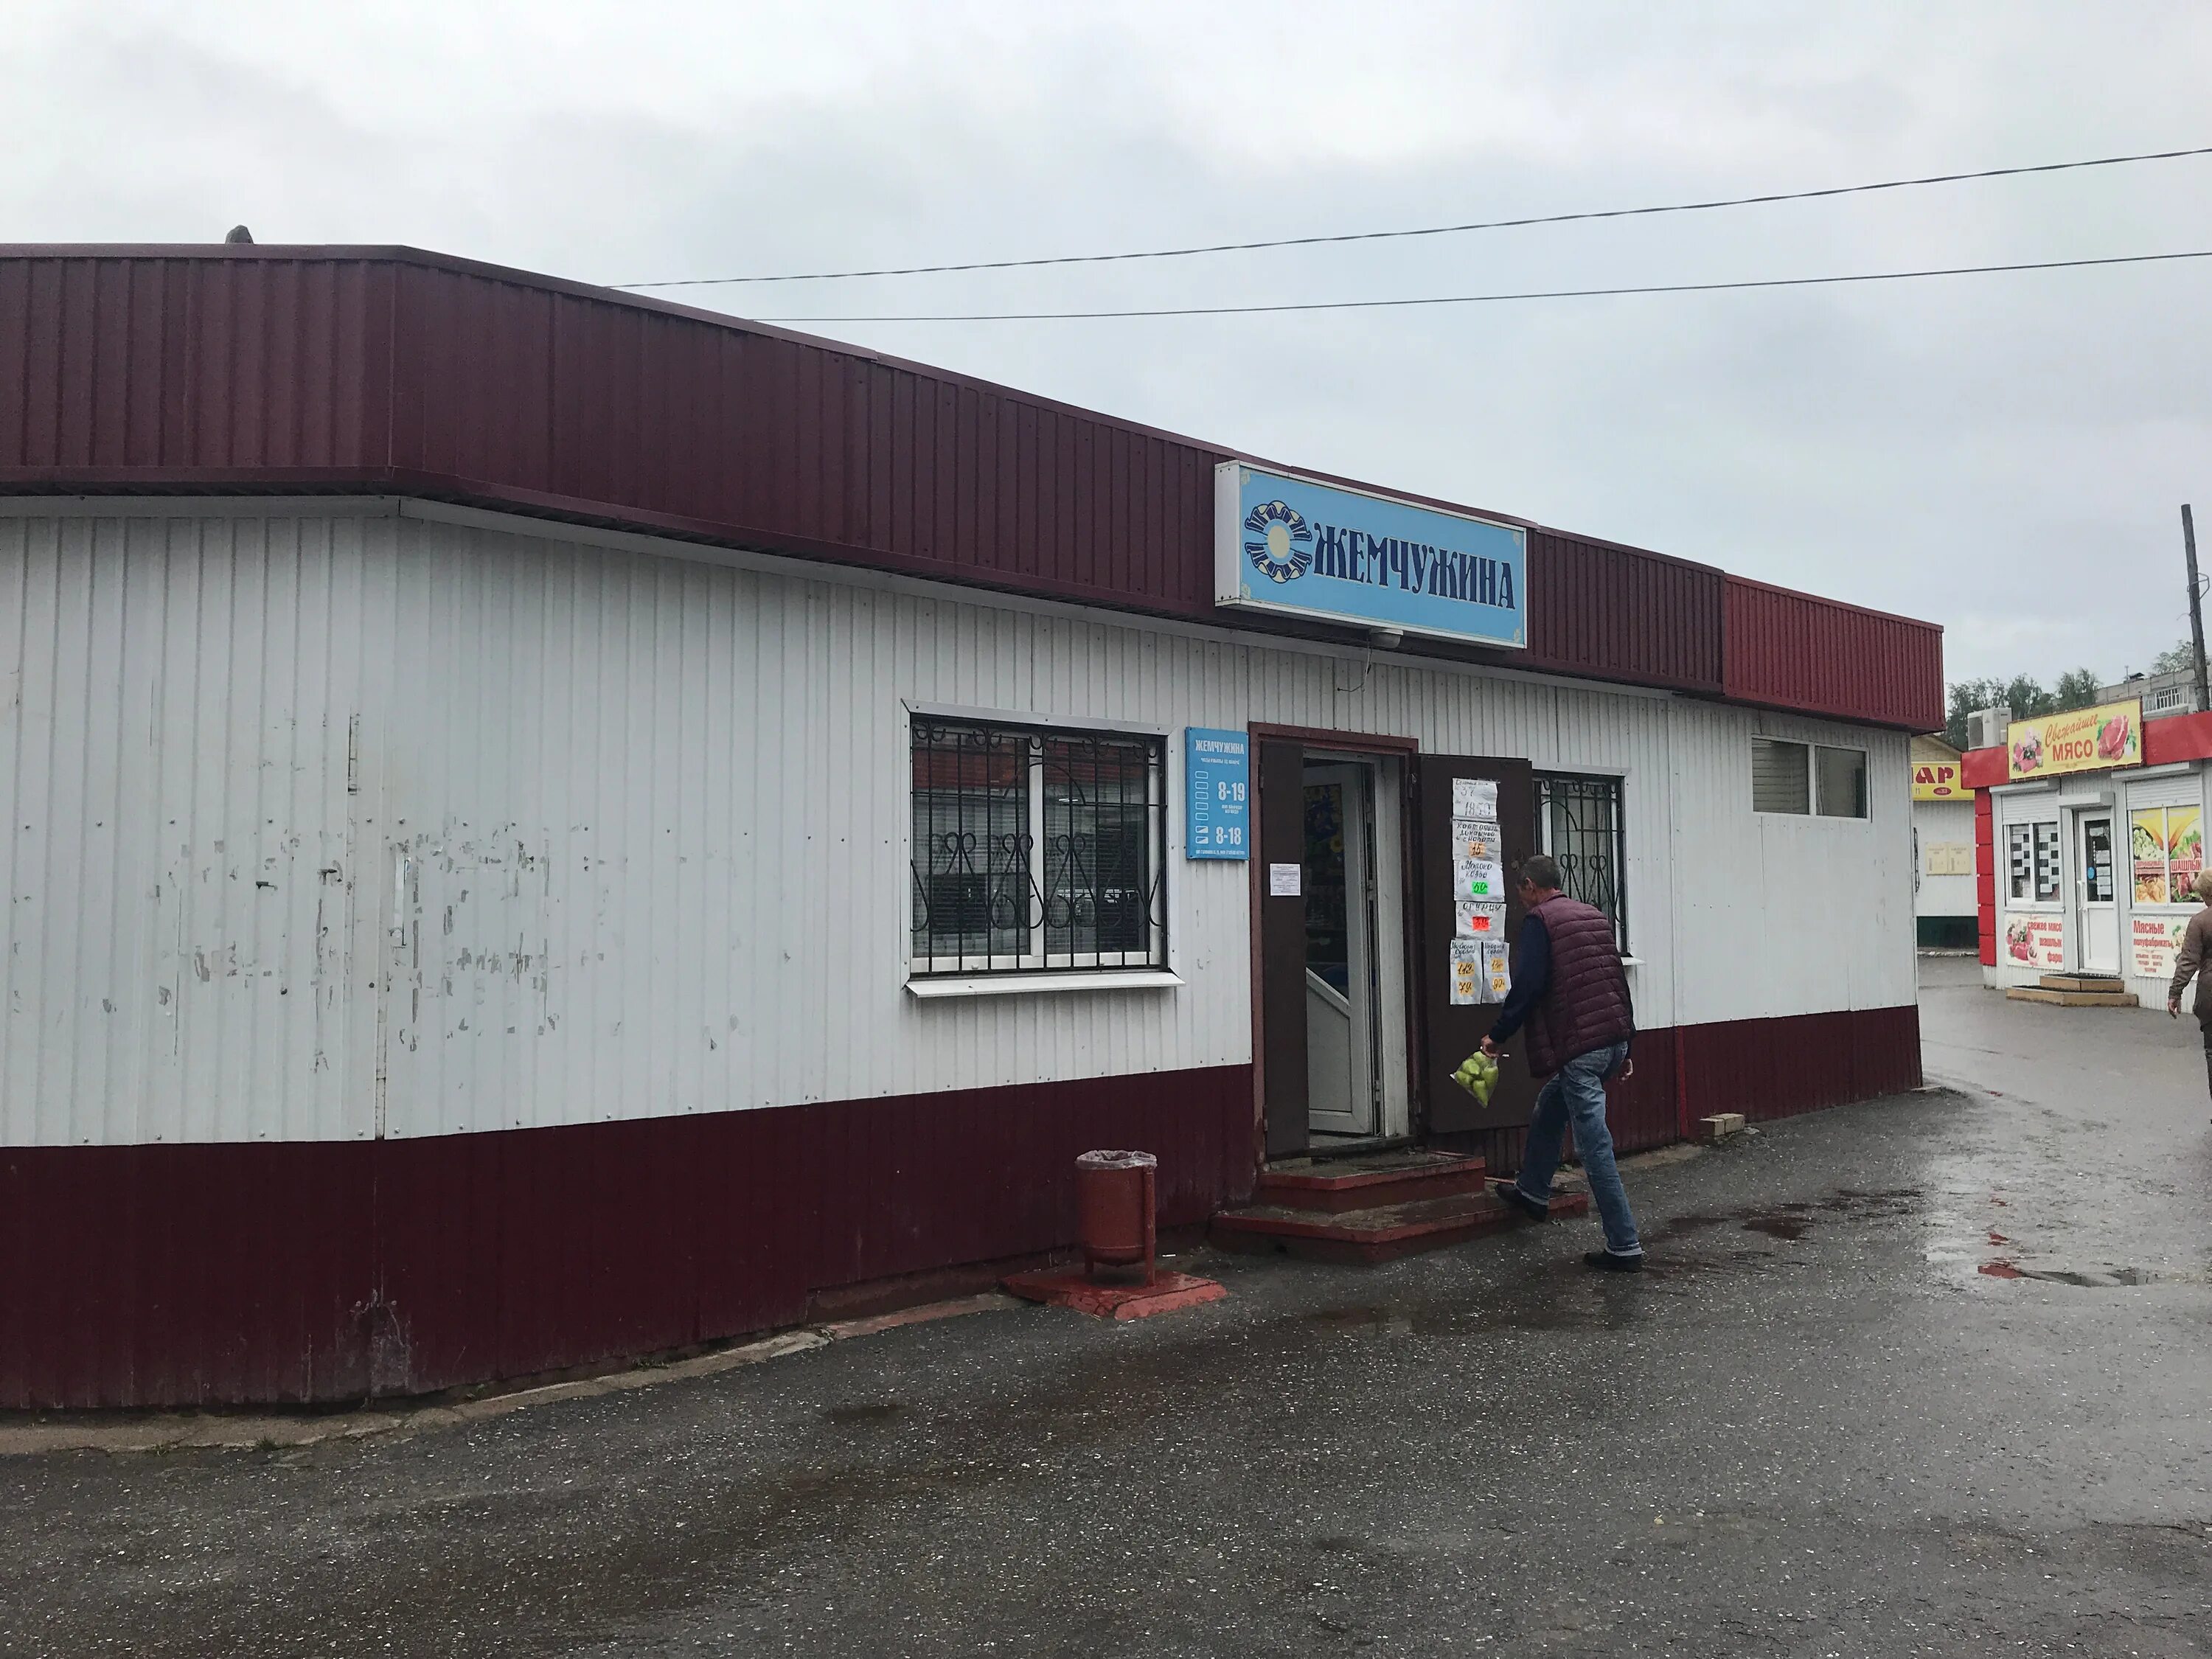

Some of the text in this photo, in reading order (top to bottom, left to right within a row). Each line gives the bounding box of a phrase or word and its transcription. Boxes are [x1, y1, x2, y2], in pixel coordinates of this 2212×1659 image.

[1313, 522, 1516, 610] ЖЕМЧУЖИНА
[2045, 714, 2098, 748] Свежайшее
[1195, 740, 1245, 755] ЖЕМЧУЖИНА
[2053, 740, 2093, 761] МЯСО
[1911, 767, 1954, 784] АР
[1218, 782, 1245, 801] 8-19
[1216, 826, 1242, 845] 8-18
[1461, 860, 1492, 870] Молоко
[2133, 920, 2165, 935] Мясные
